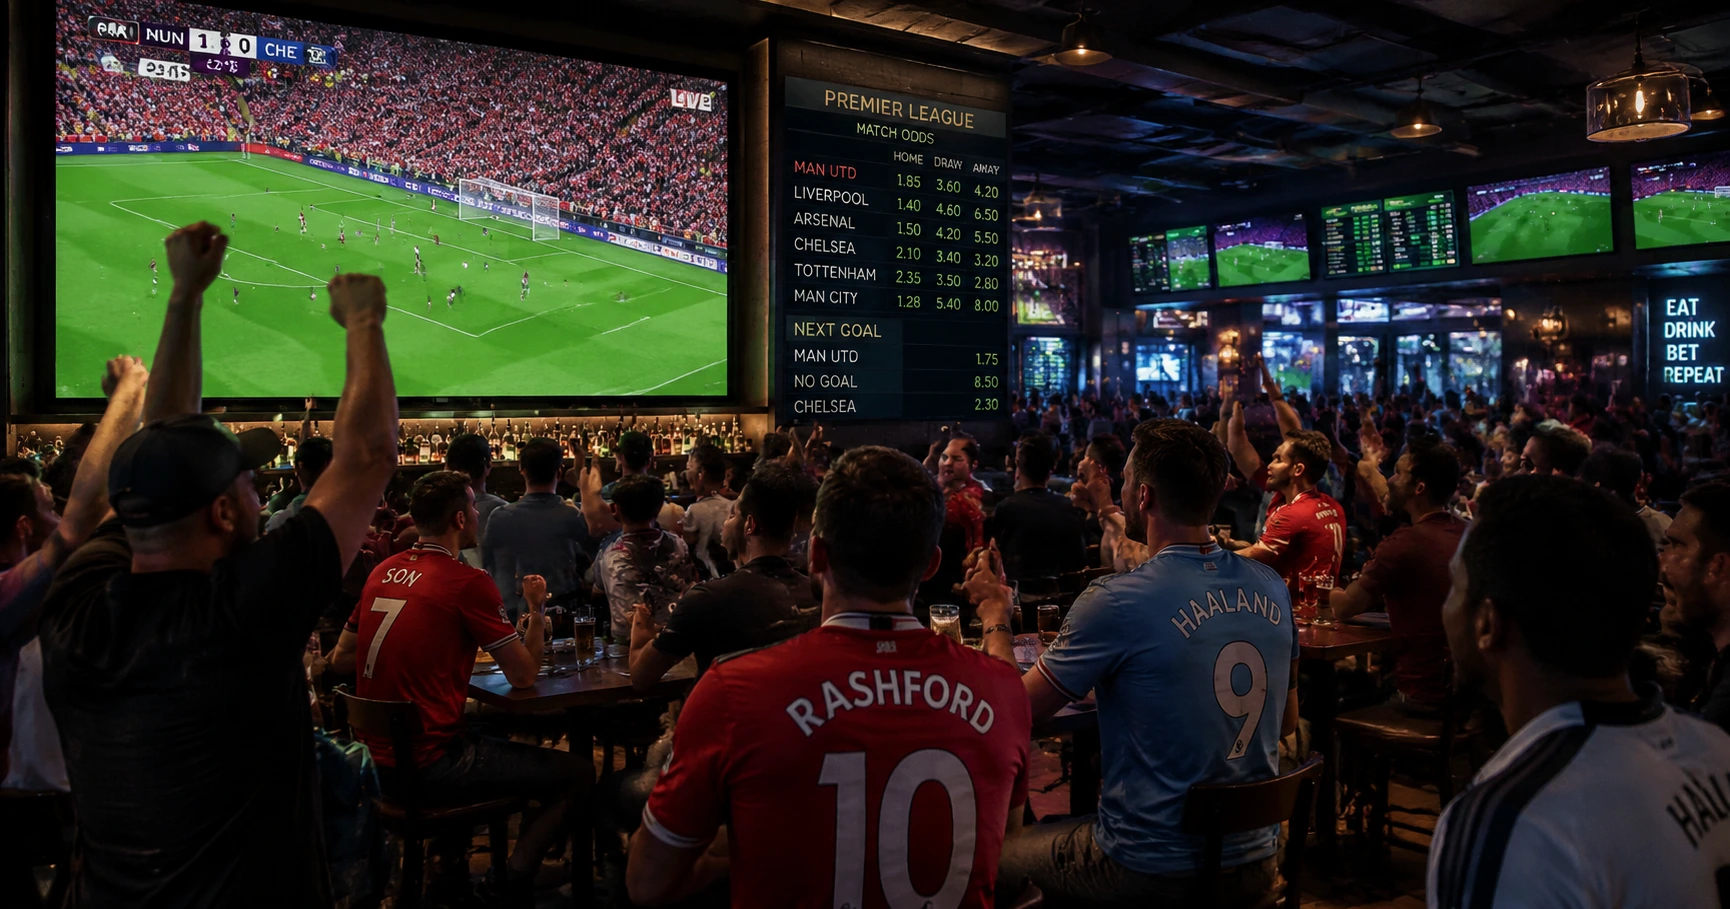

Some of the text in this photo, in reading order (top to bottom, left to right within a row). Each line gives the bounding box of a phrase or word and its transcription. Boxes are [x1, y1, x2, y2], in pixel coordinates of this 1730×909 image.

[145, 28, 184, 46] NUN
[197, 33, 206, 49] 1
[238, 38, 249, 55] 0
[264, 43, 297, 59] CHE
[826, 90, 973, 128] PREMIER LEAGUE
[857, 123, 934, 144] MATCH ODDS
[894, 151, 923, 164] HOME
[935, 157, 962, 169] DRAW
[795, 161, 998, 198] MAN UTD 1.85 3.60 4.20
[795, 186, 998, 221] LIVERPOOL 1.40 4.60 6.50
[794, 212, 998, 244] ARSENAL 1.50 4.20 5.50
[795, 237, 998, 267] CHELSEA 2.10 3.40 3.20
[795, 264, 998, 289] TOTTENHAM 2.35 3.50 2.80
[795, 290, 998, 312] MAN CITY 1.28 5.40 8.00
[1667, 298, 1699, 316] EAT
[795, 322, 881, 337] NEXT GOAL
[1665, 321, 1715, 338] DRINK
[795, 349, 998, 365] MAN UTD 1.75
[1667, 344, 1699, 360] BET
[795, 375, 998, 388] NO GOAL 8.50
[1665, 367, 1724, 383] REPEAT
[795, 398, 998, 413] CHELSEA 2.30
[381, 568, 423, 588] SON
[1170, 587, 1281, 639] HAALAND
[362, 596, 407, 679] 7
[785, 669, 995, 737] RASHFORD
[1213, 640, 1268, 761] 9
[817, 748, 977, 909] 10
